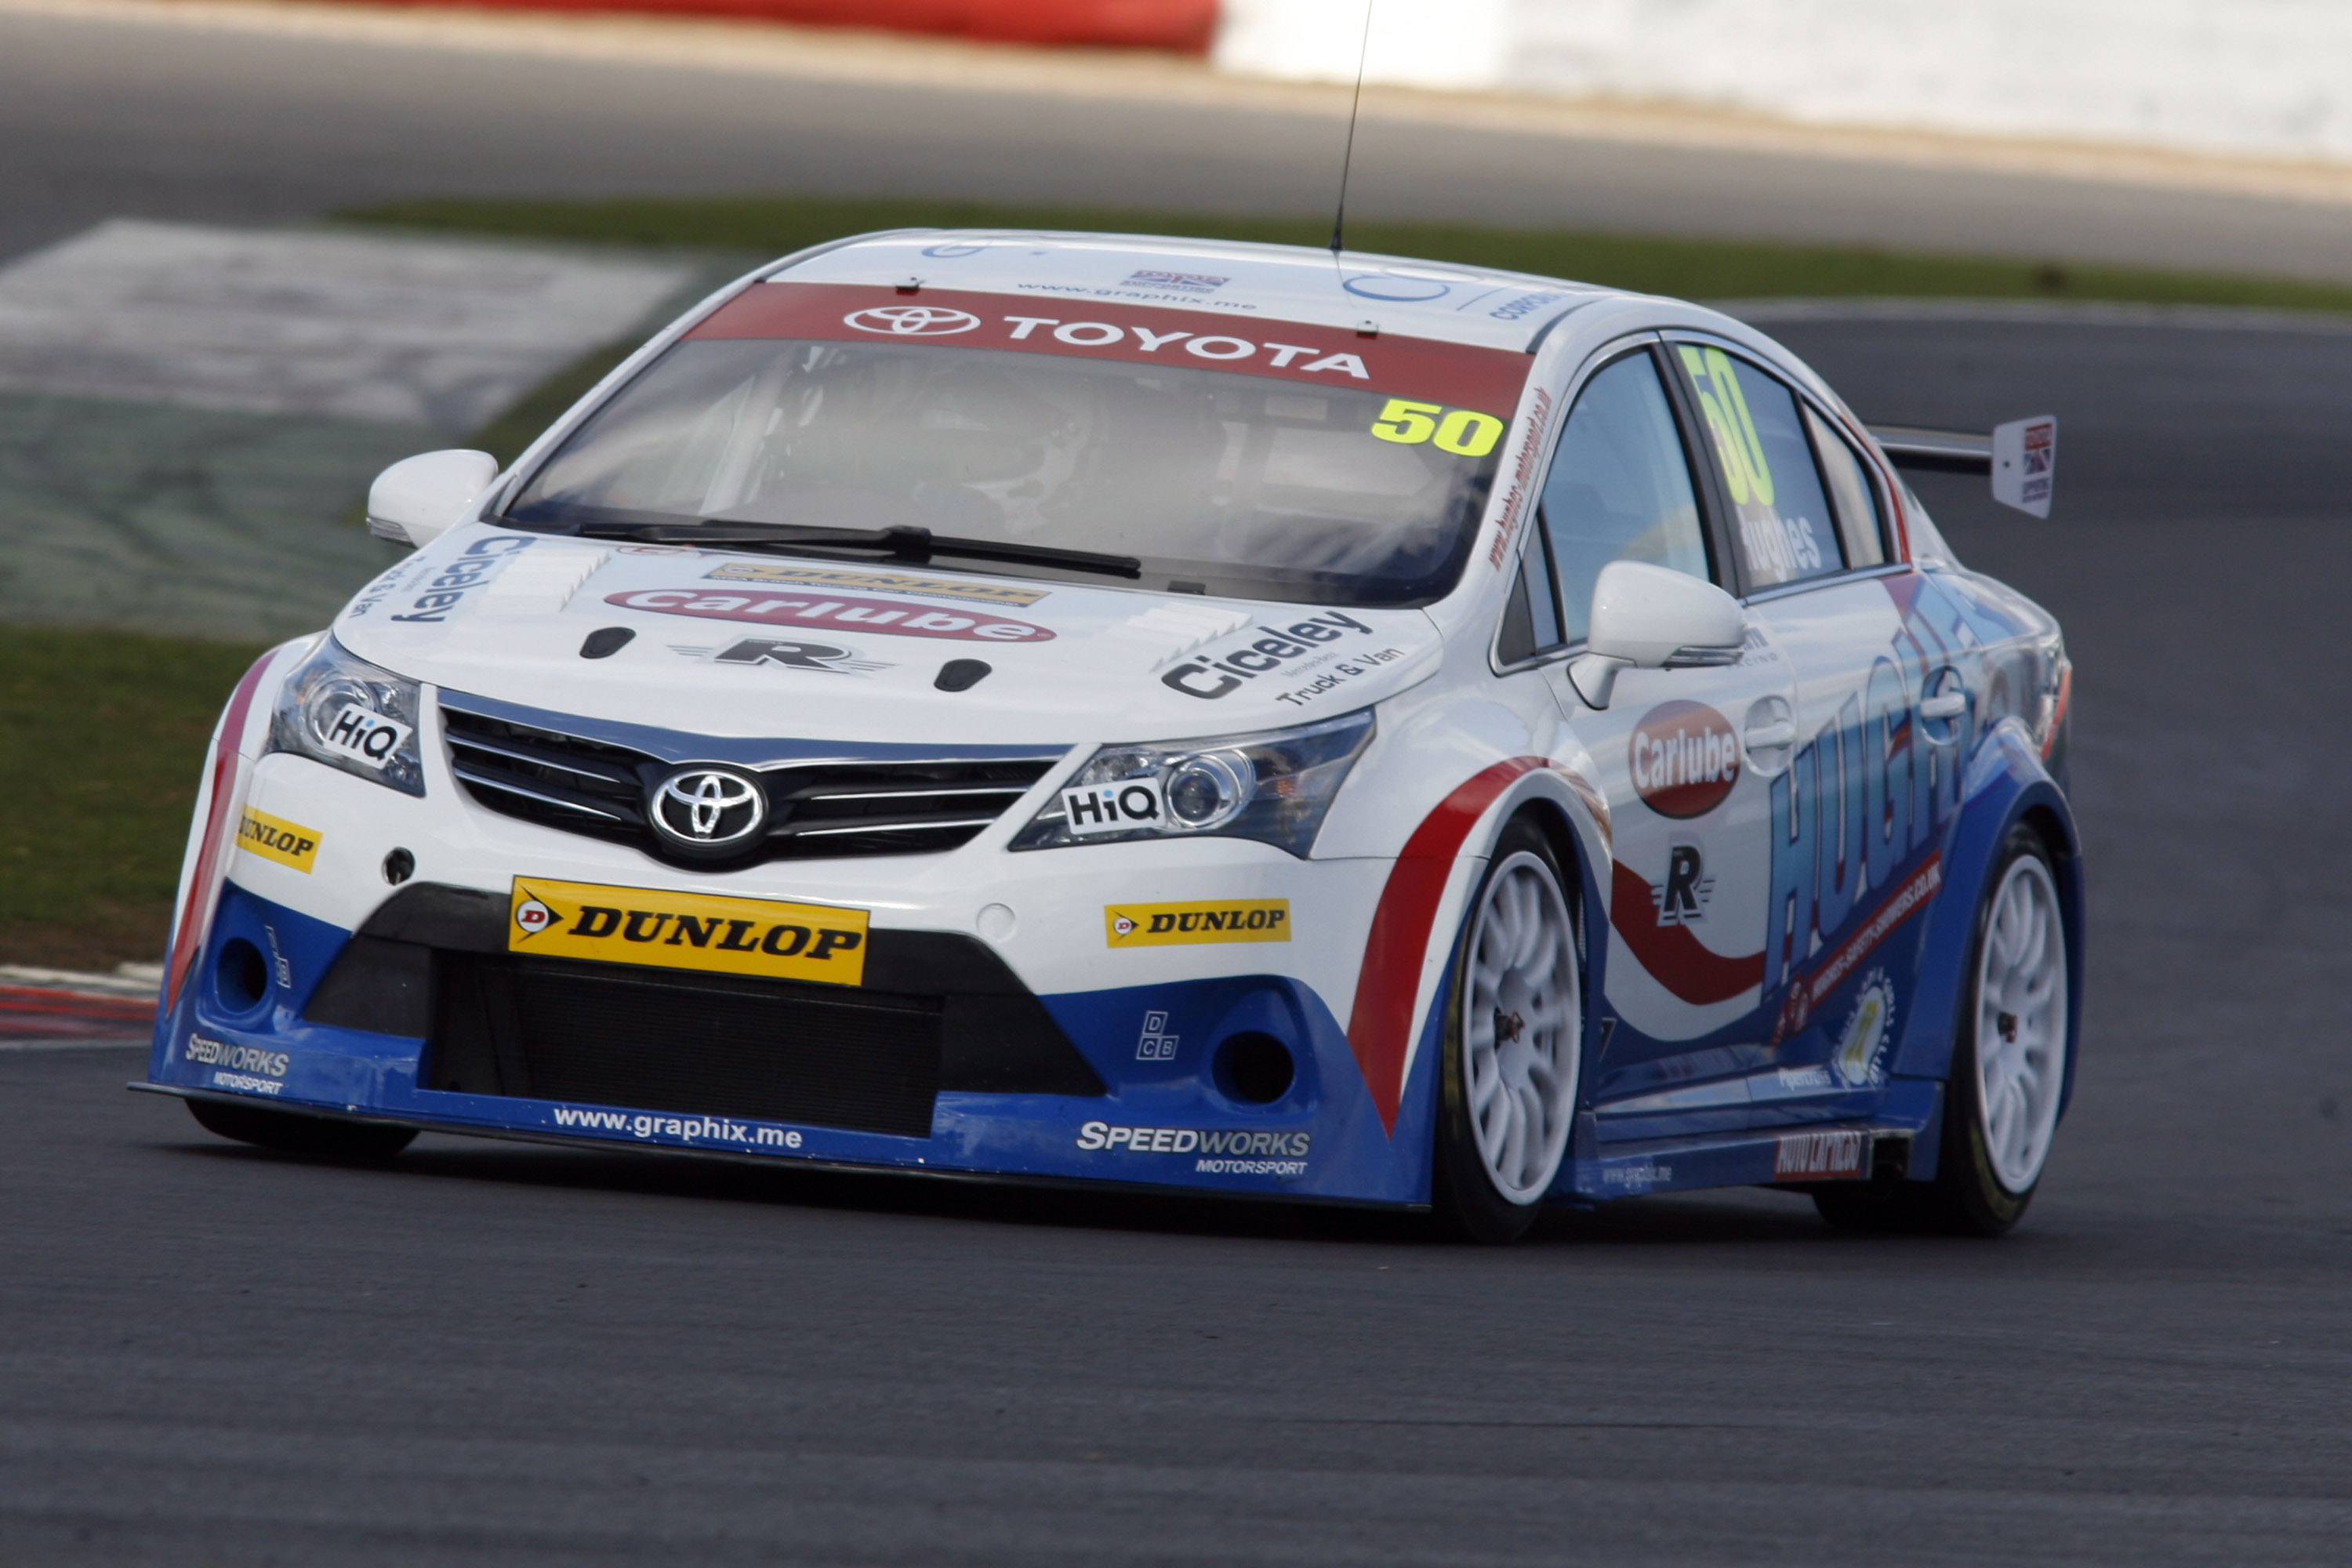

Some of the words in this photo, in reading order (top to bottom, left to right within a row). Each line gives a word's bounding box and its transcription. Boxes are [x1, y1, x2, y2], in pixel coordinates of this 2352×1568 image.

[1018, 283, 1257, 310] www.graphix.me
[1004, 316, 1370, 379] TOYOTA
[1371, 398, 1504, 457] 50
[1678, 345, 1775, 506] 50
[390, 535, 538, 622] Ciceley
[768, 569, 1040, 597] DUNLOP
[1161, 610, 1374, 699] Ciceley
[1276, 669, 1347, 706] Truck
[1335, 663, 1366, 677] &
[1352, 646, 1406, 667] Van
[328, 710, 397, 761] HiQ
[1634, 726, 1737, 789] Carlube
[1067, 785, 1160, 827] HiQ
[1656, 845, 1704, 921] R
[521, 909, 546, 924] D
[568, 905, 862, 960] DUNLOP
[1147, 909, 1285, 934] DUNLOP
[185, 1033, 290, 1078] SPEEDWORKS
[212, 1071, 284, 1095] MOTORSPORT
[554, 1106, 803, 1150] www.graphix.me
[1076, 1120, 1310, 1156] SPEEDWORKS
[1196, 1159, 1307, 1174] MOTORSPORT
